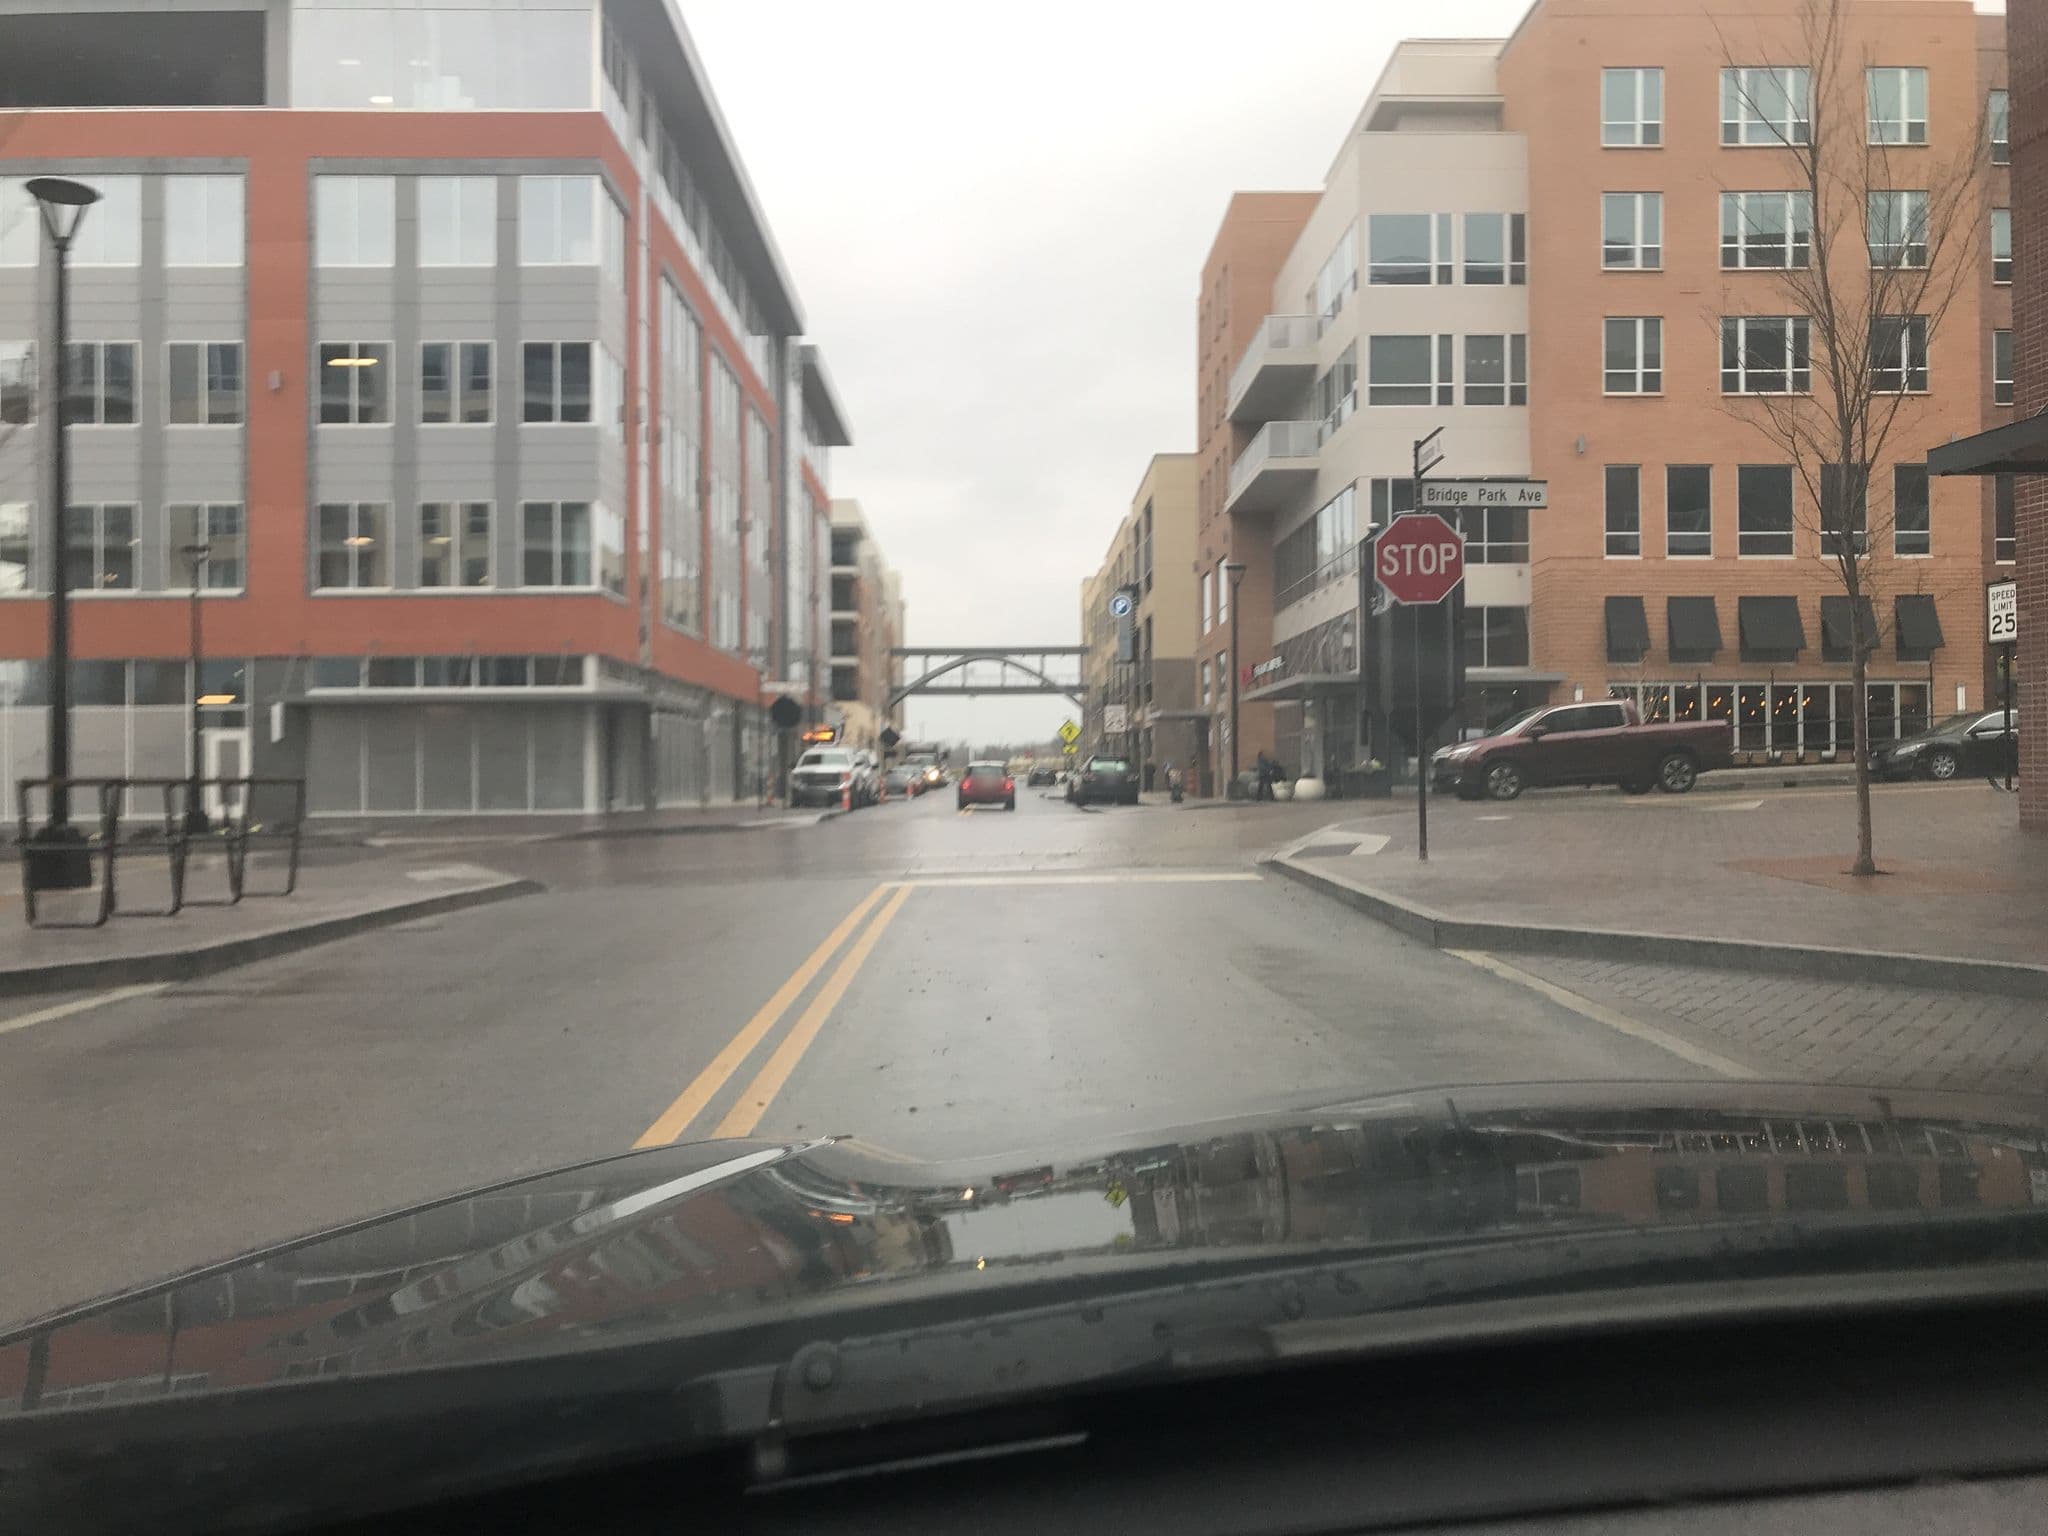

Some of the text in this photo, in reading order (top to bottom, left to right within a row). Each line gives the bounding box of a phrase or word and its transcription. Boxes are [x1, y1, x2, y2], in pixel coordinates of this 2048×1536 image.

[1427, 487, 1542, 505] Bridge Park Ave
[1381, 543, 1457, 576] STOP
[1991, 590, 2016, 600] SPEED
[1993, 601, 2013, 612] LIMIT
[1992, 613, 2015, 634] 25
